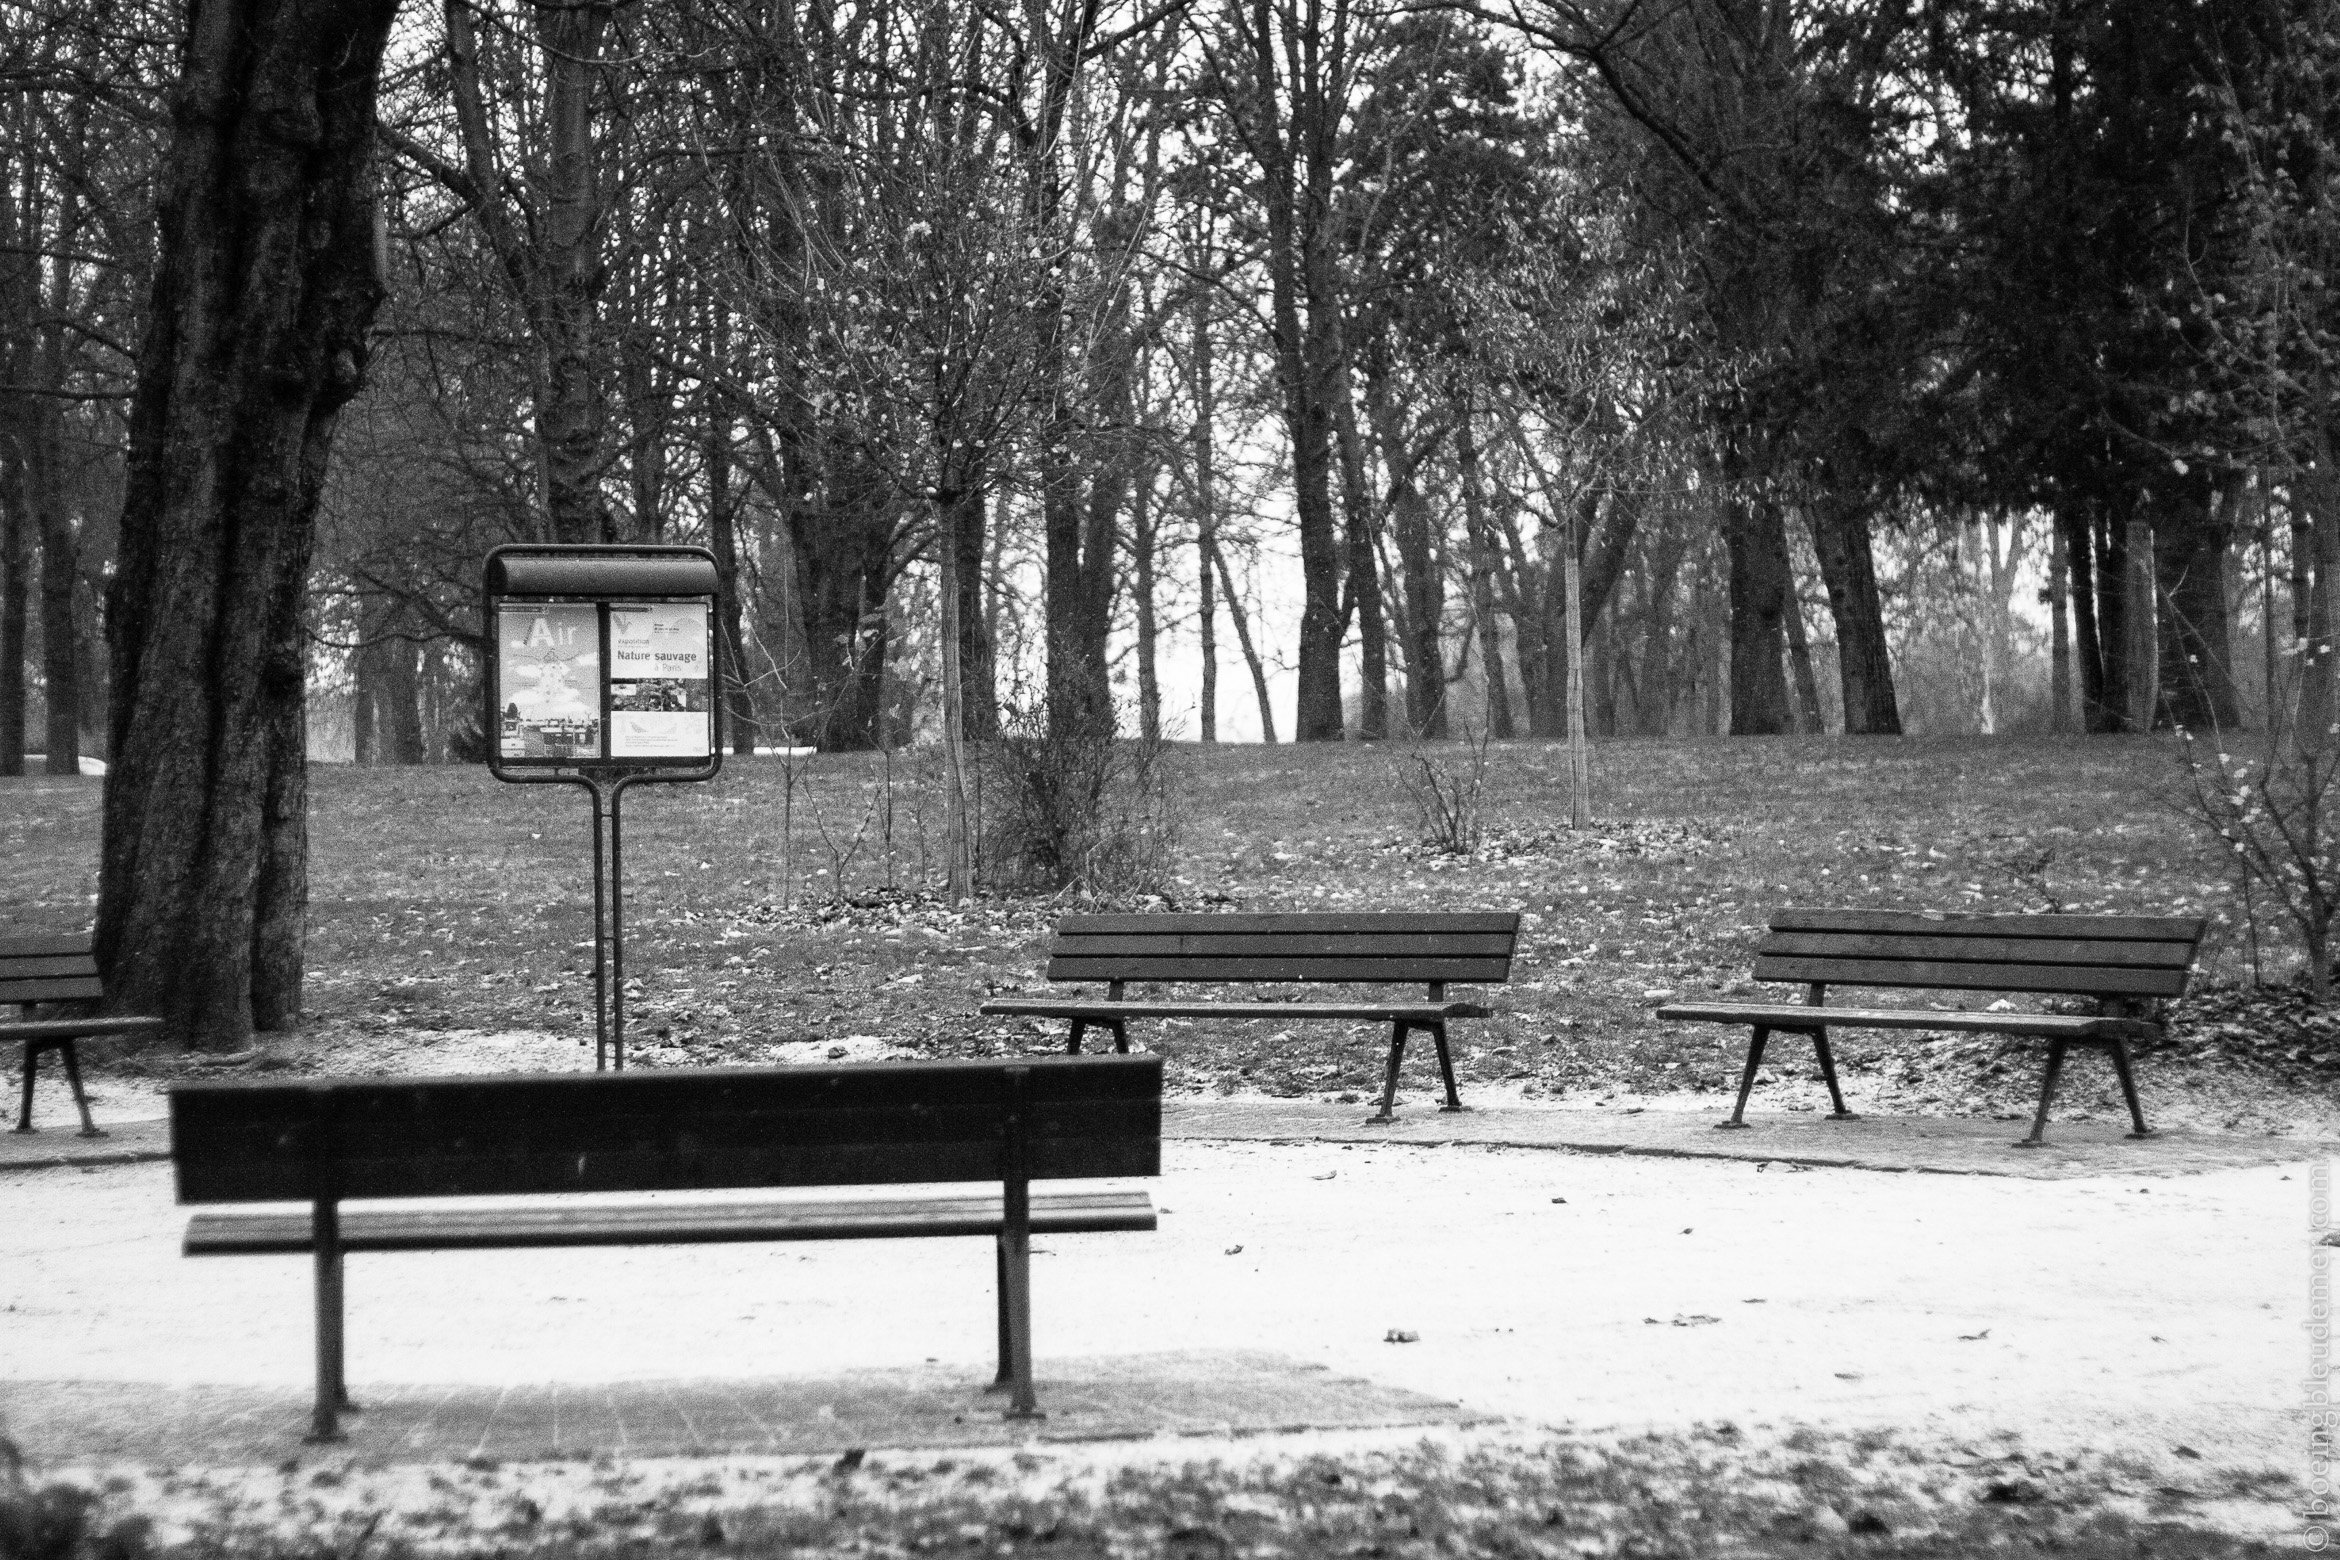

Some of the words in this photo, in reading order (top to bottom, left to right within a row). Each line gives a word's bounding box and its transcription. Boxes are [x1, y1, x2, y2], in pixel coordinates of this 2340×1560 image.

[530, 618, 577, 648] Air
[617, 650, 651, 661] Nature
[654, 652, 697, 663] sauvage
[662, 663, 682, 671] Paris
